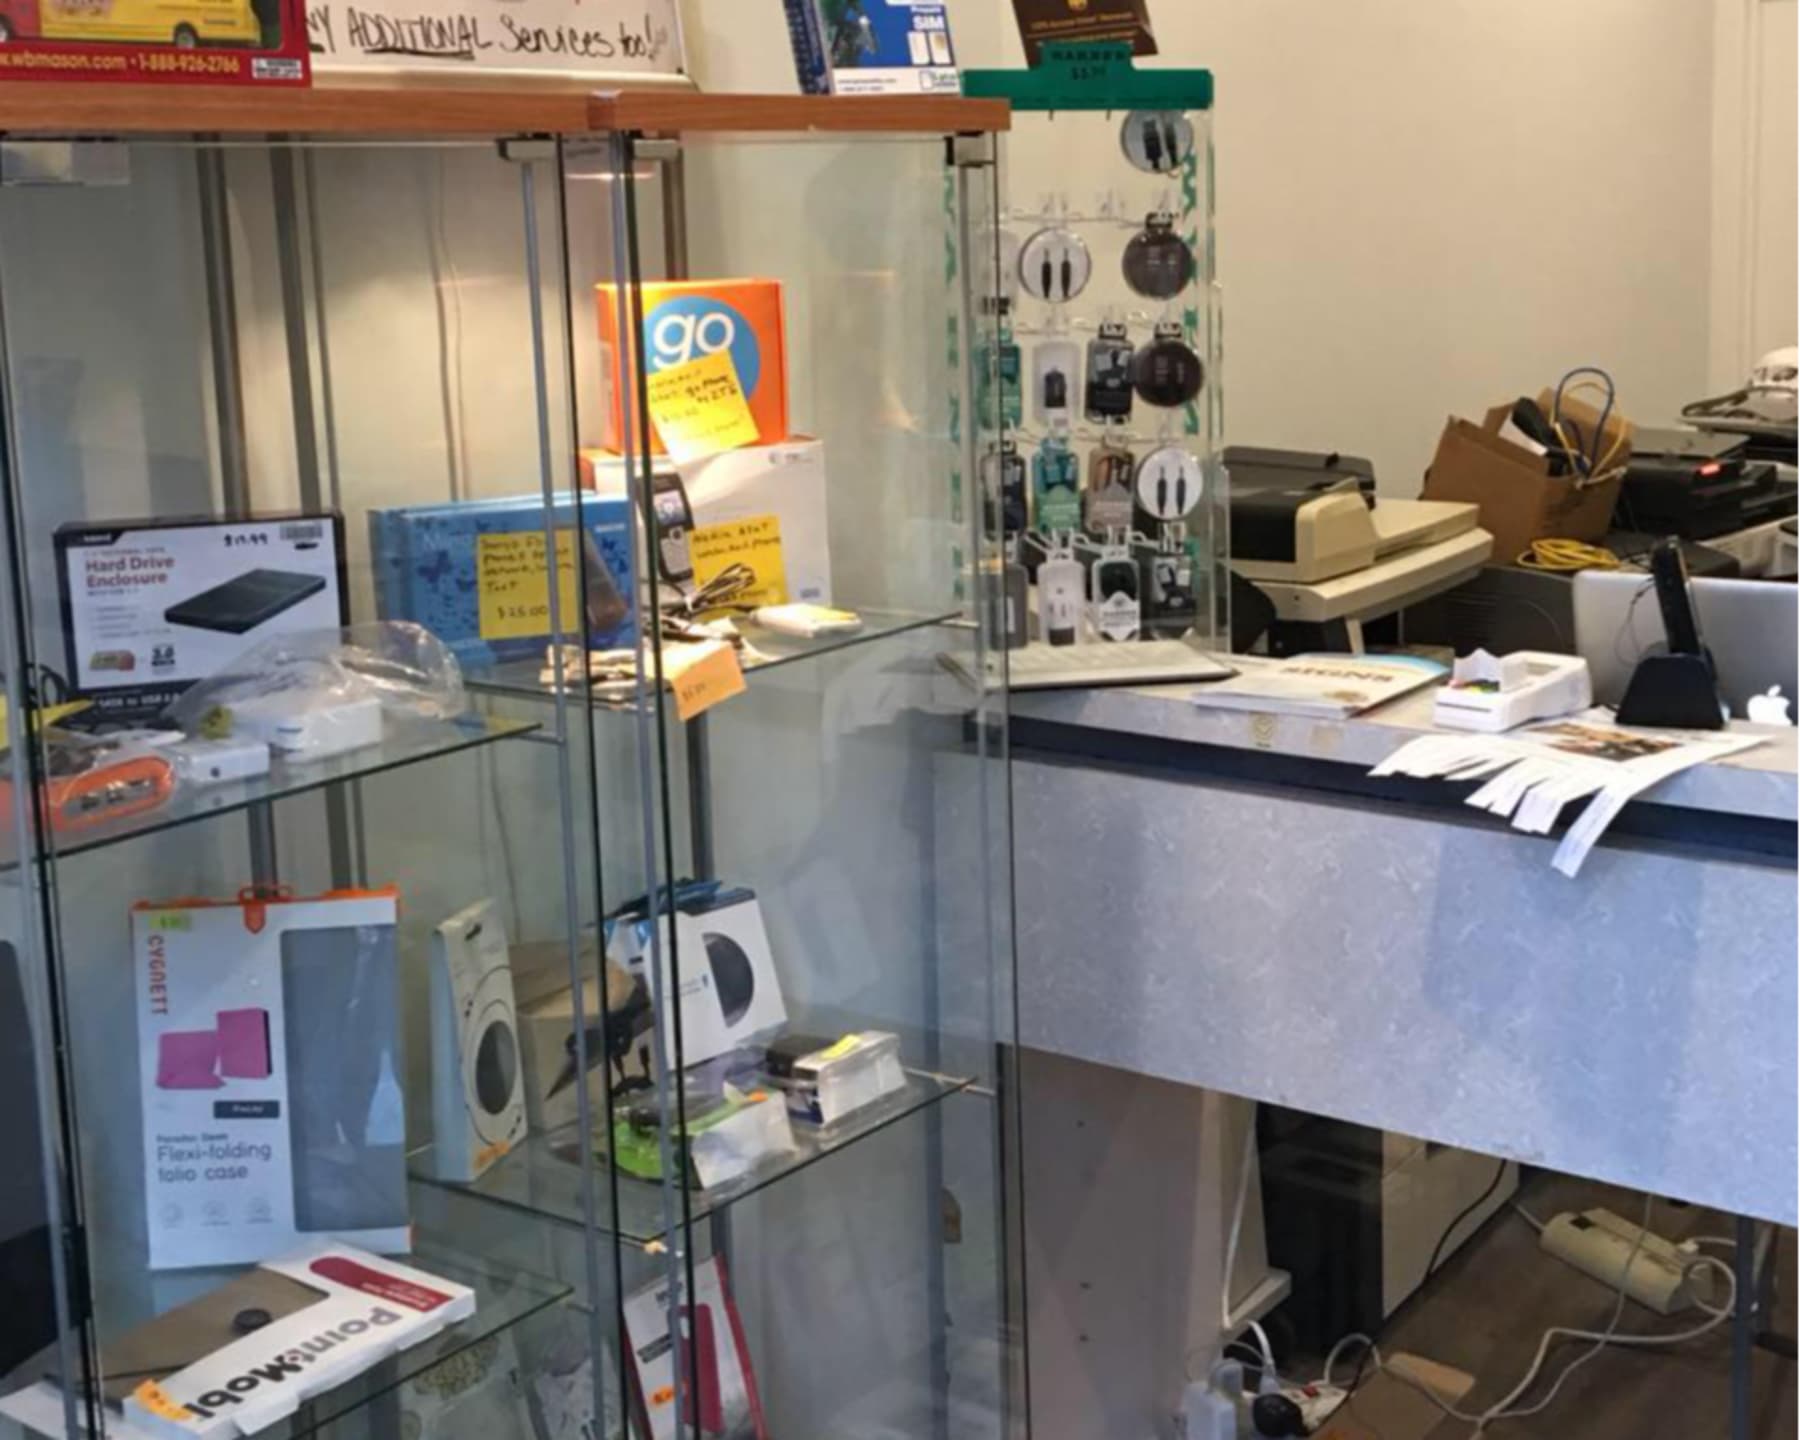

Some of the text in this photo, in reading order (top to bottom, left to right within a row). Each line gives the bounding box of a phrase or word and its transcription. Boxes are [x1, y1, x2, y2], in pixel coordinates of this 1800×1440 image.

[348, 8, 492, 53] ADDITIONAL
[499, 15, 616, 58] Services
[652, 311, 735, 371] go
[86, 555, 175, 572] Hard Drive
[87, 572, 168, 588] Enclosure
[156, 1141, 272, 1161] Flexi-folding
[157, 1165, 249, 1183] folio case
